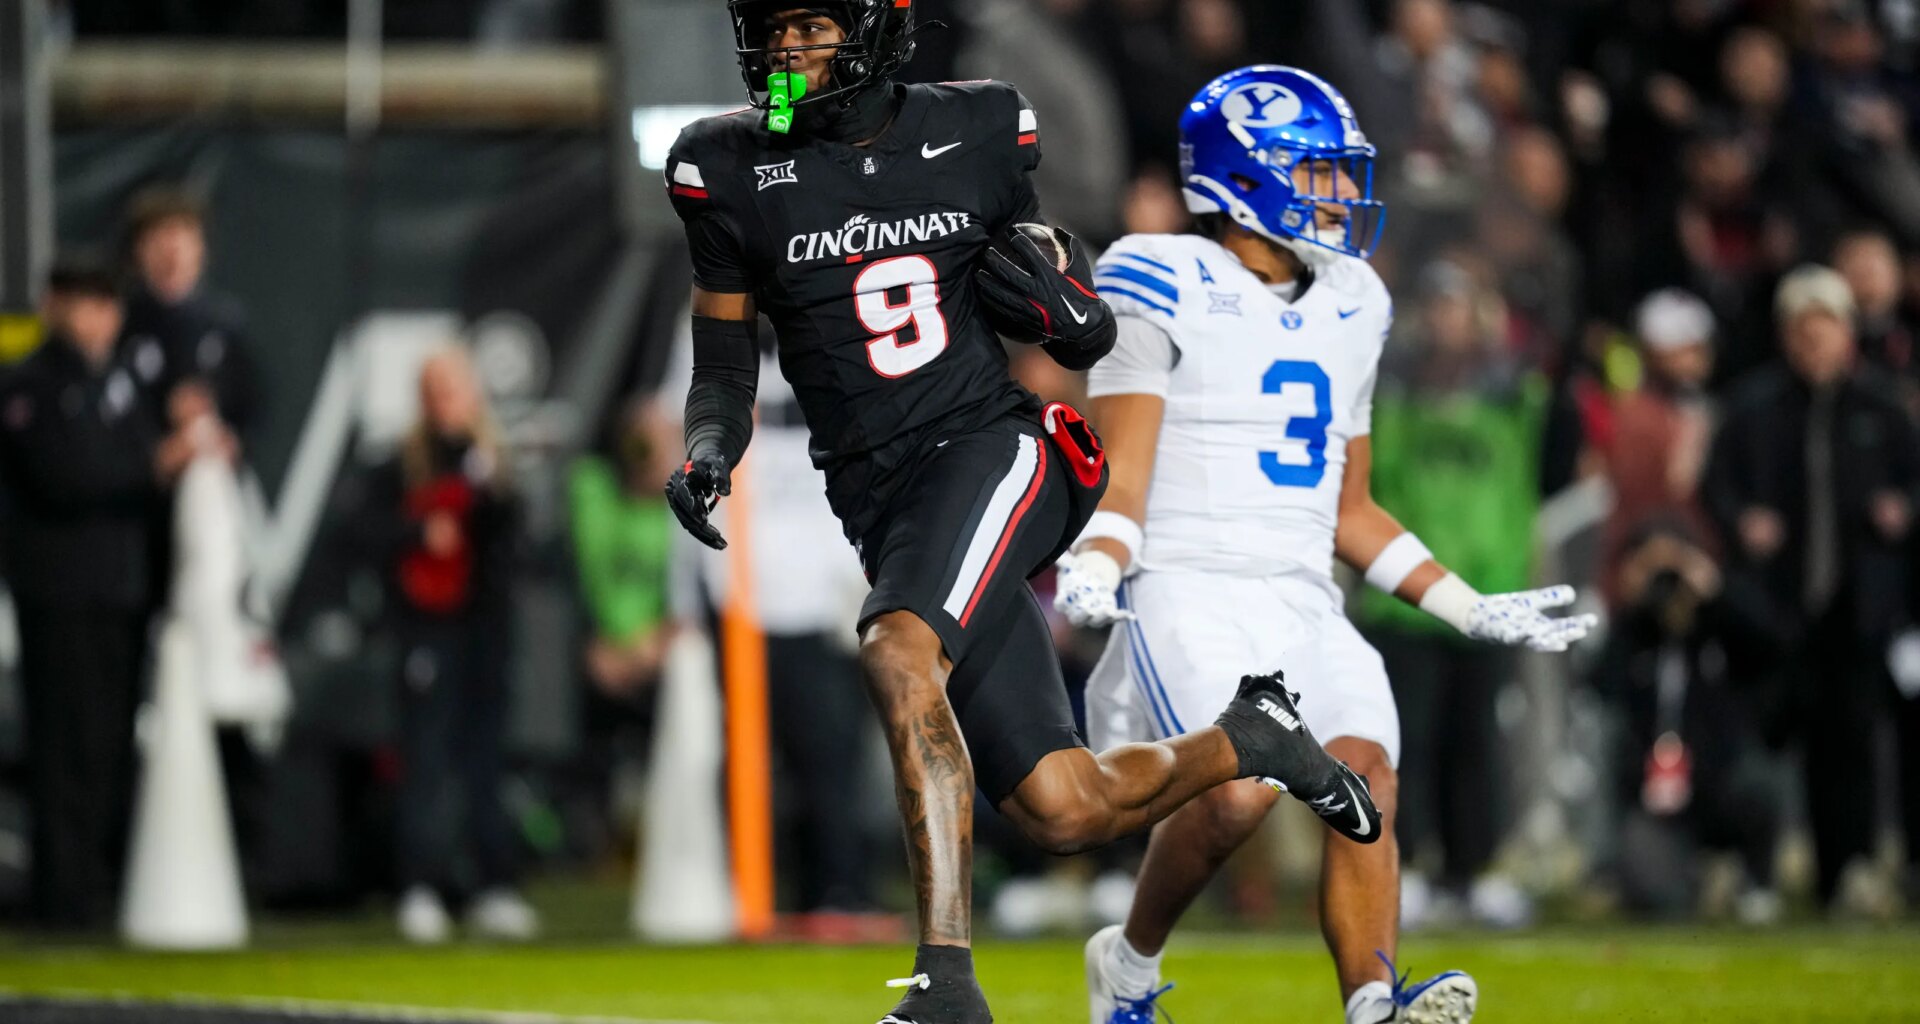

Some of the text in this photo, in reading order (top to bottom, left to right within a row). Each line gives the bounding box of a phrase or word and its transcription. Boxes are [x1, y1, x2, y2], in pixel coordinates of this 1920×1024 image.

[1237, 87, 1289, 121] Y
[863, 157, 873, 166] JK
[864, 165, 875, 174] 58
[853, 254, 949, 379] 9
[1258, 359, 1332, 488] 3
